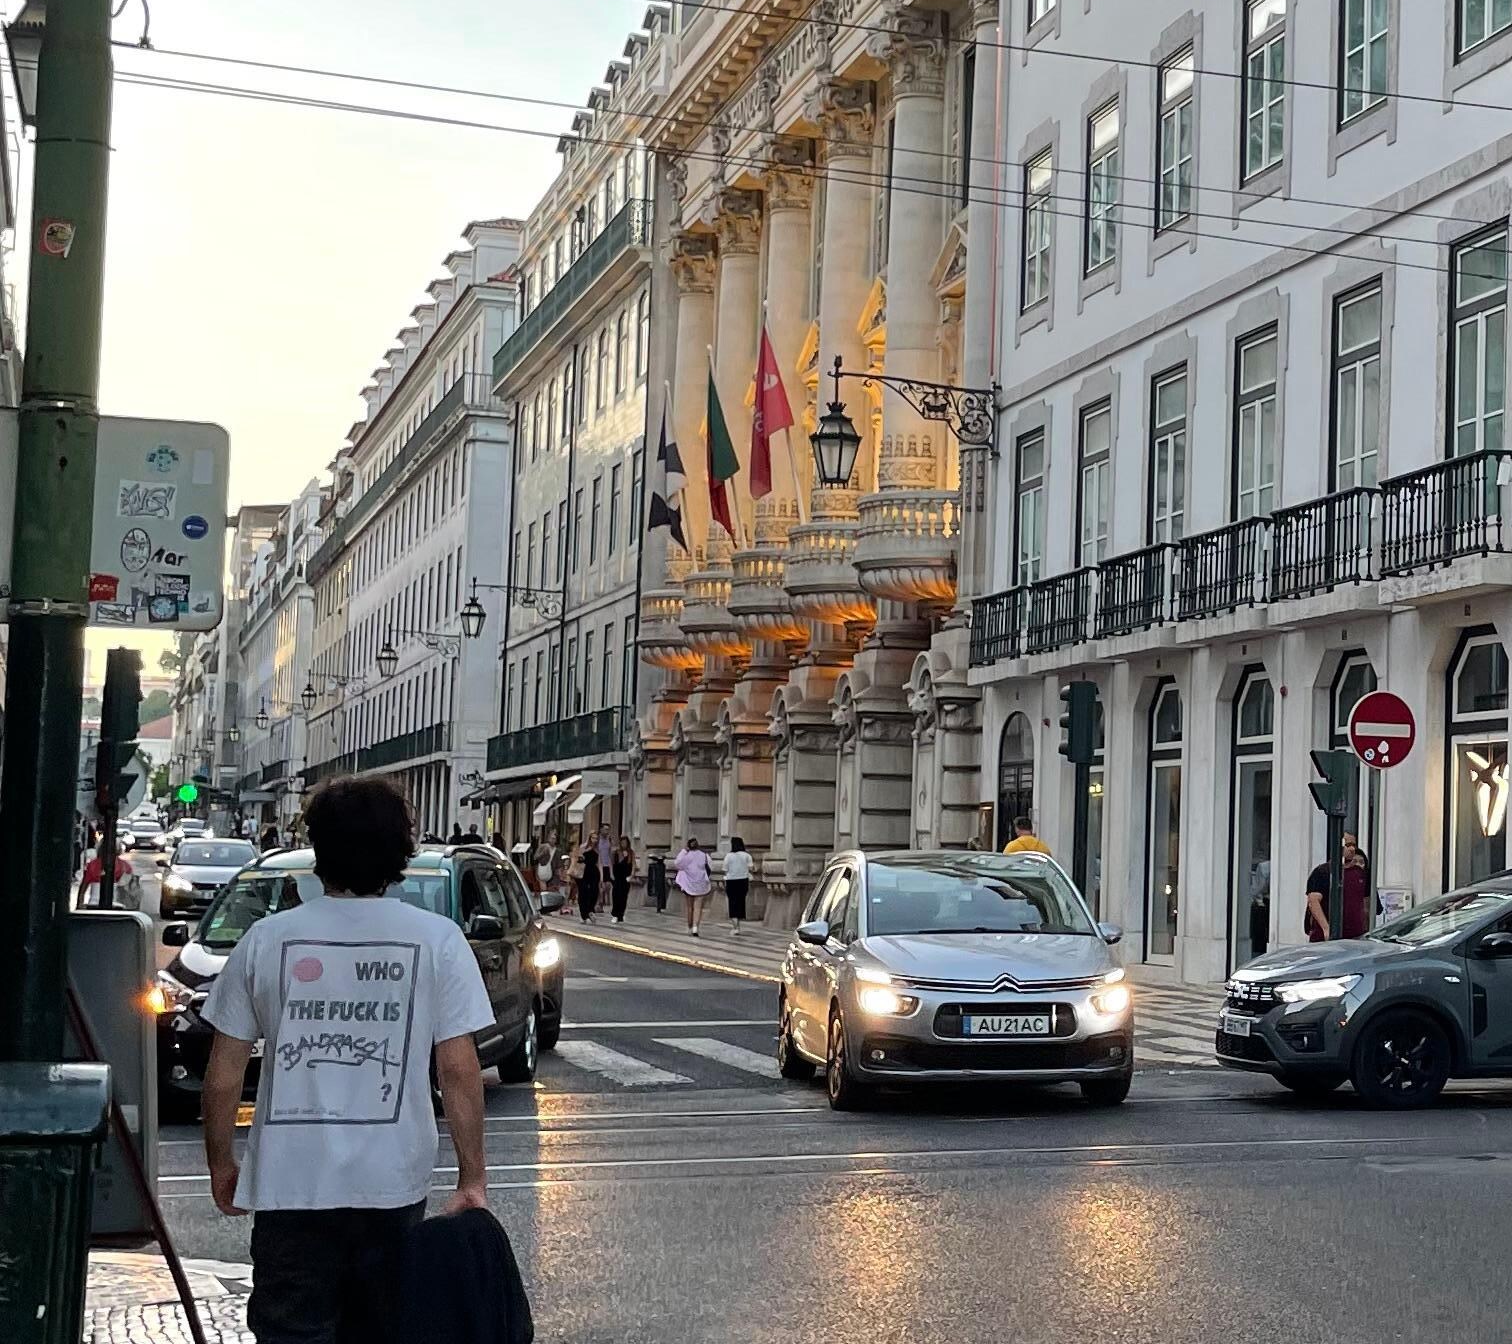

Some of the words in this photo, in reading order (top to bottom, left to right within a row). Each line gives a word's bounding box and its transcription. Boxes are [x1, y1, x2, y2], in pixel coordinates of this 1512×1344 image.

[355, 961, 405, 981] WHO
[288, 1000, 325, 1021] THE
[327, 1000, 379, 1021] FUCK
[382, 1001, 401, 1021] IS
